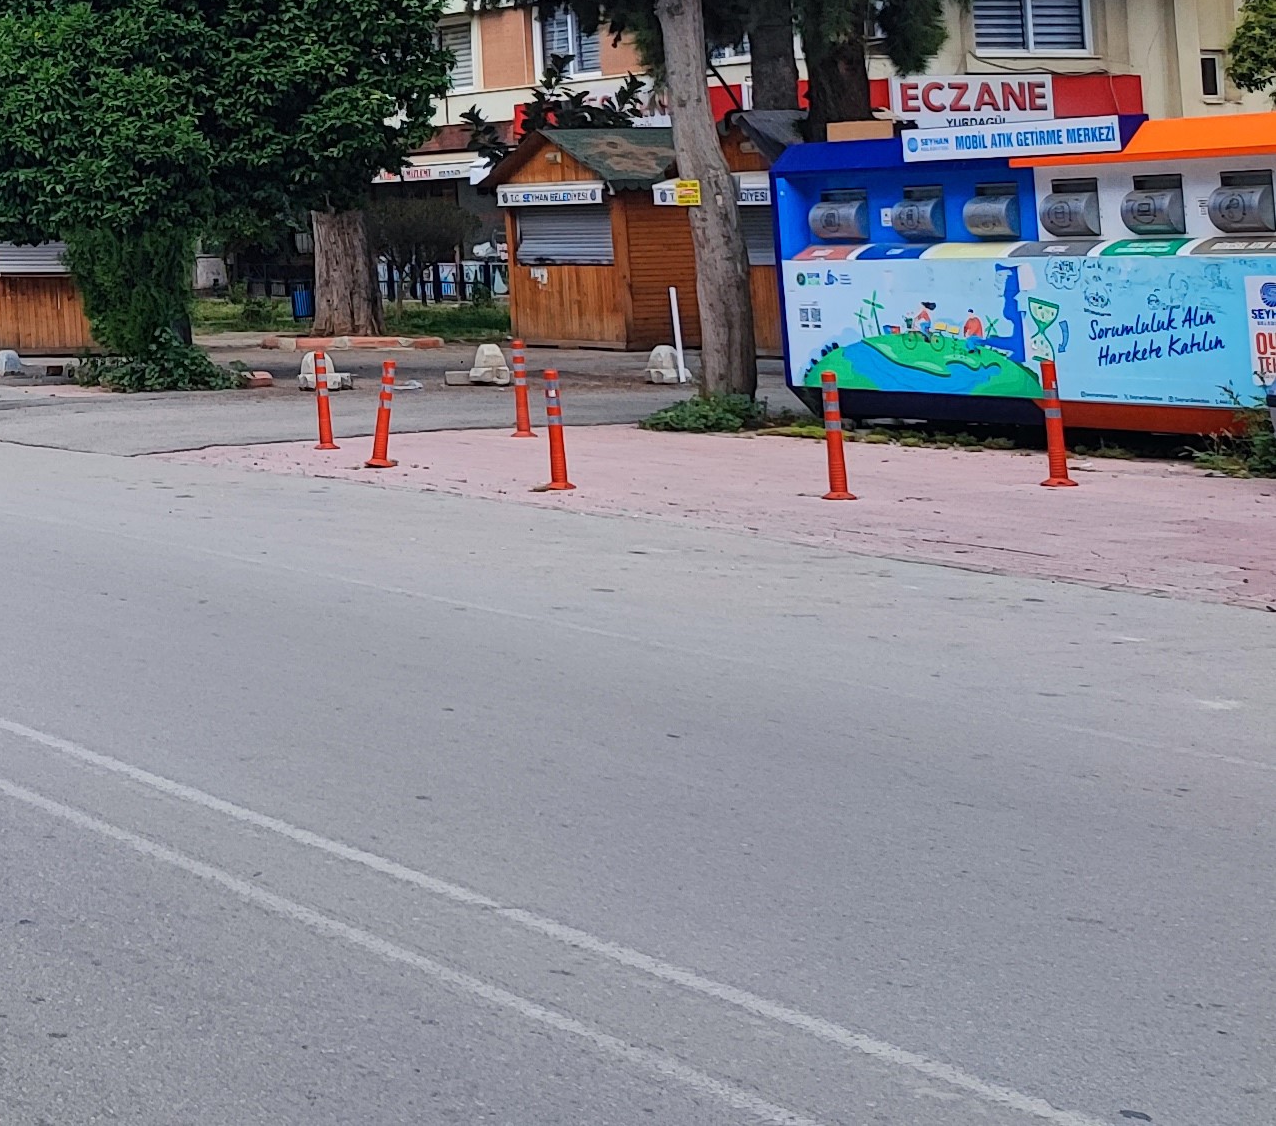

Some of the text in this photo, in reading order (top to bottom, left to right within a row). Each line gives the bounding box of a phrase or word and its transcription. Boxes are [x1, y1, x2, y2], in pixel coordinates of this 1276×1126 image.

[899, 81, 1048, 112] ECZANE
[955, 122, 1116, 151] MOBİL ATIK GETİRME MERKEZİ
[1089, 306, 1216, 341] Sorumluluk Alın
[1098, 331, 1225, 366] Harekete Katılın
